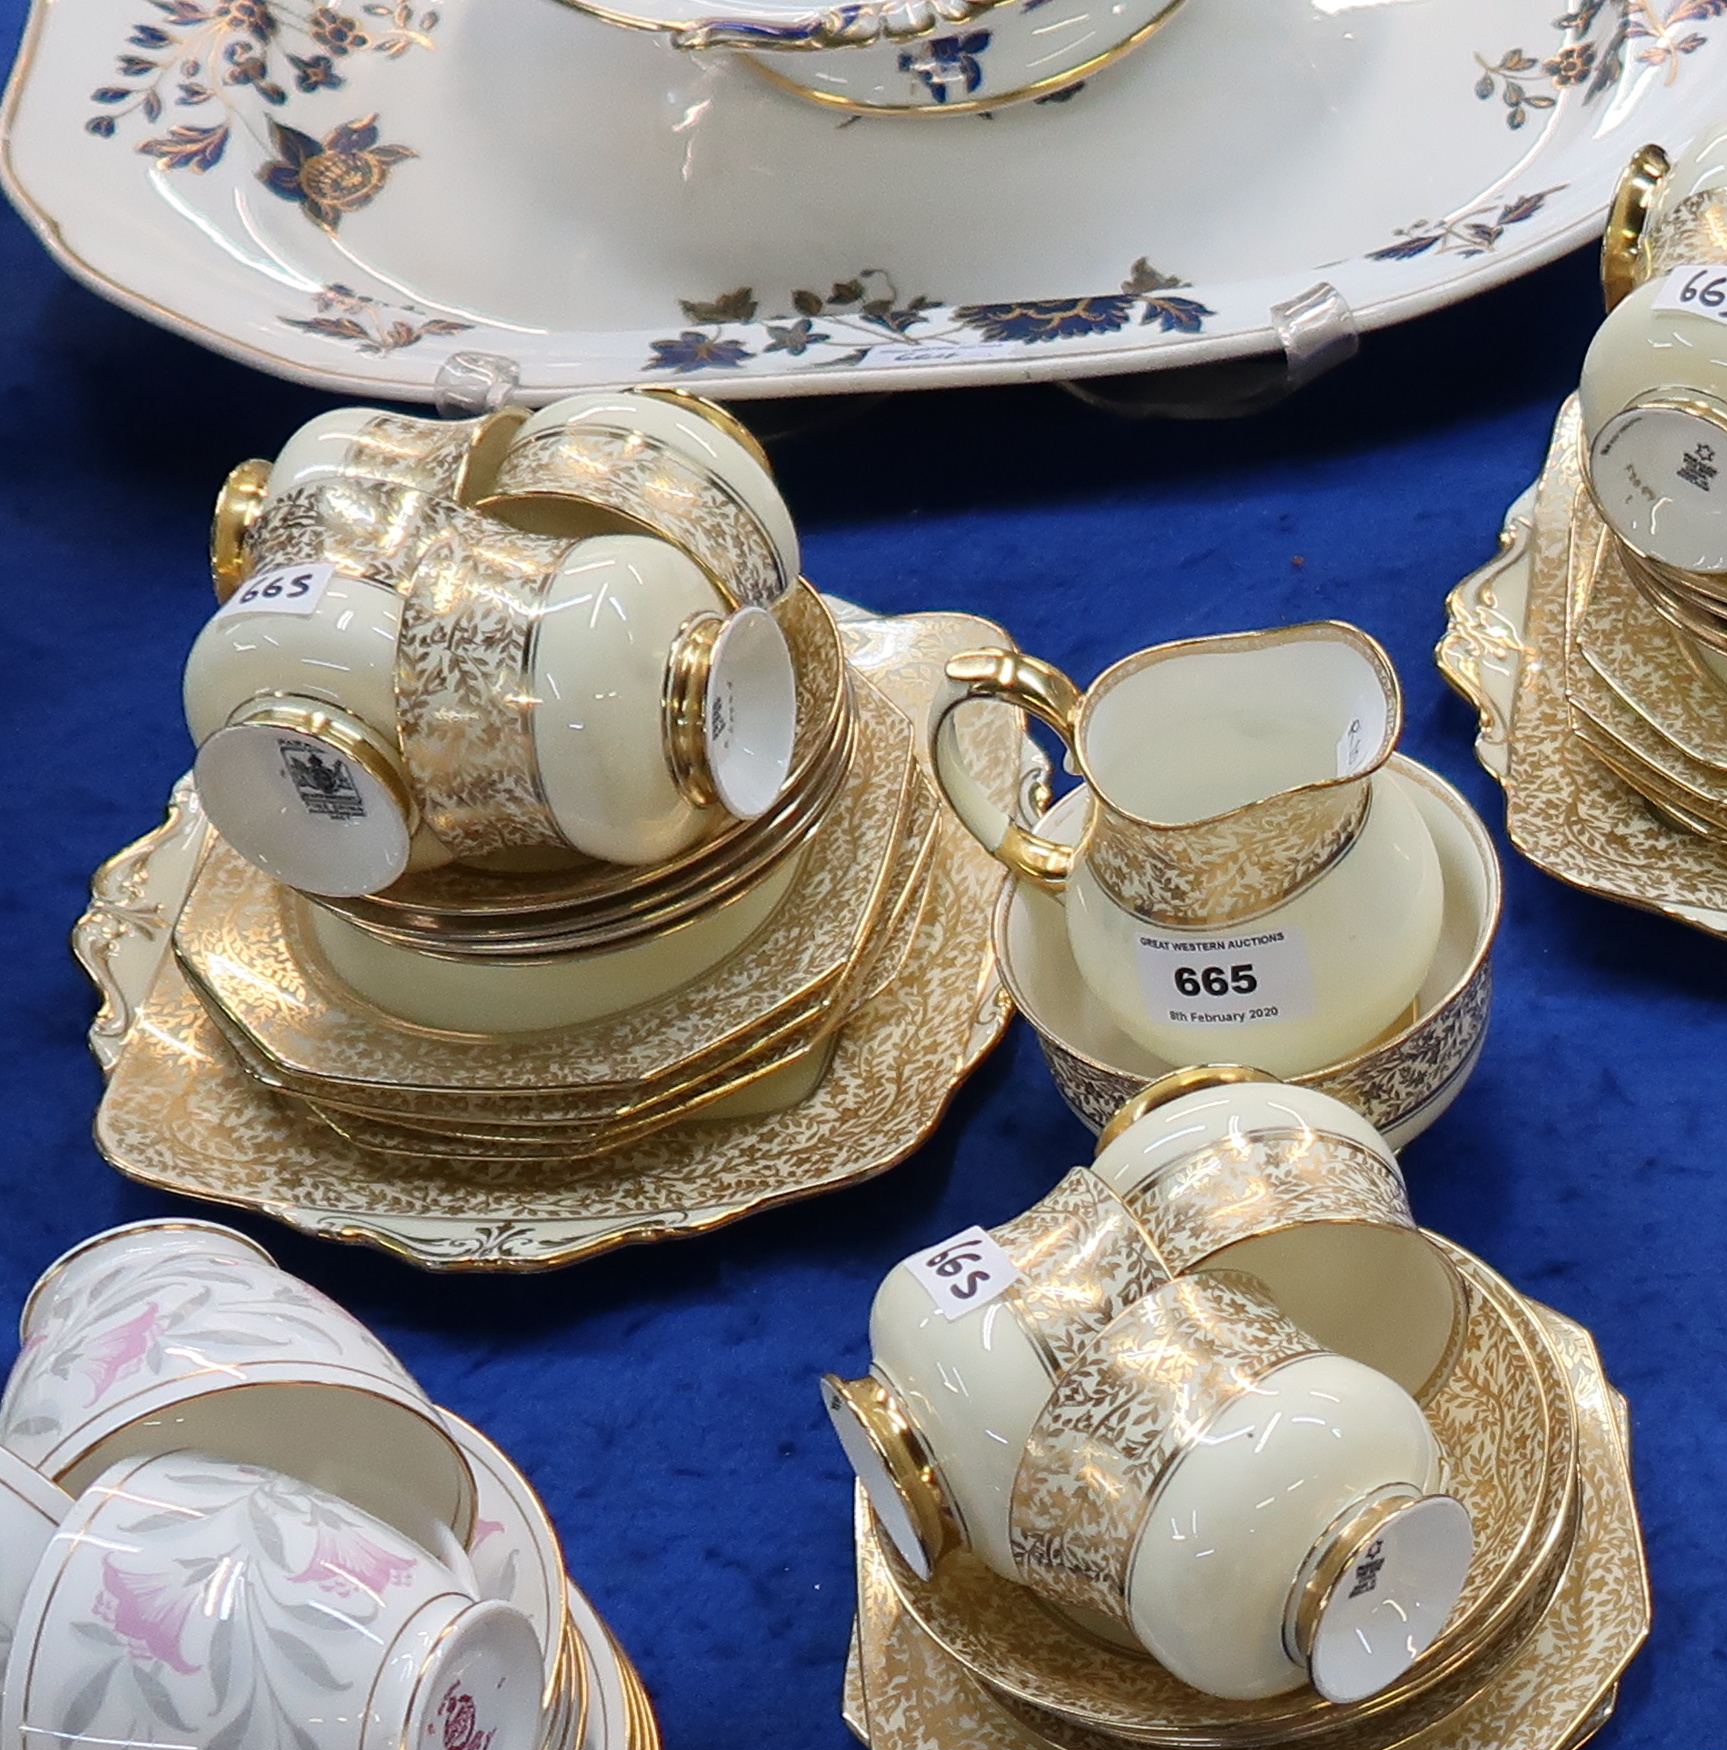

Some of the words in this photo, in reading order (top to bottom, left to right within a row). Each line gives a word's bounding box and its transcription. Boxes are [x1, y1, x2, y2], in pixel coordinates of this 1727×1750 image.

[239, 574, 313, 604] 665
[1140, 937, 1169, 950] GREAT
[1171, 941, 1225, 952] WESTERN
[1227, 932, 1285, 949] AUCTIONS
[1174, 964, 1257, 996] 665
[1169, 1010, 1187, 1022] 8th
[1190, 1011, 1245, 1023] February
[1249, 1006, 1279, 1019] 2020
[925, 1239, 991, 1300] 665
